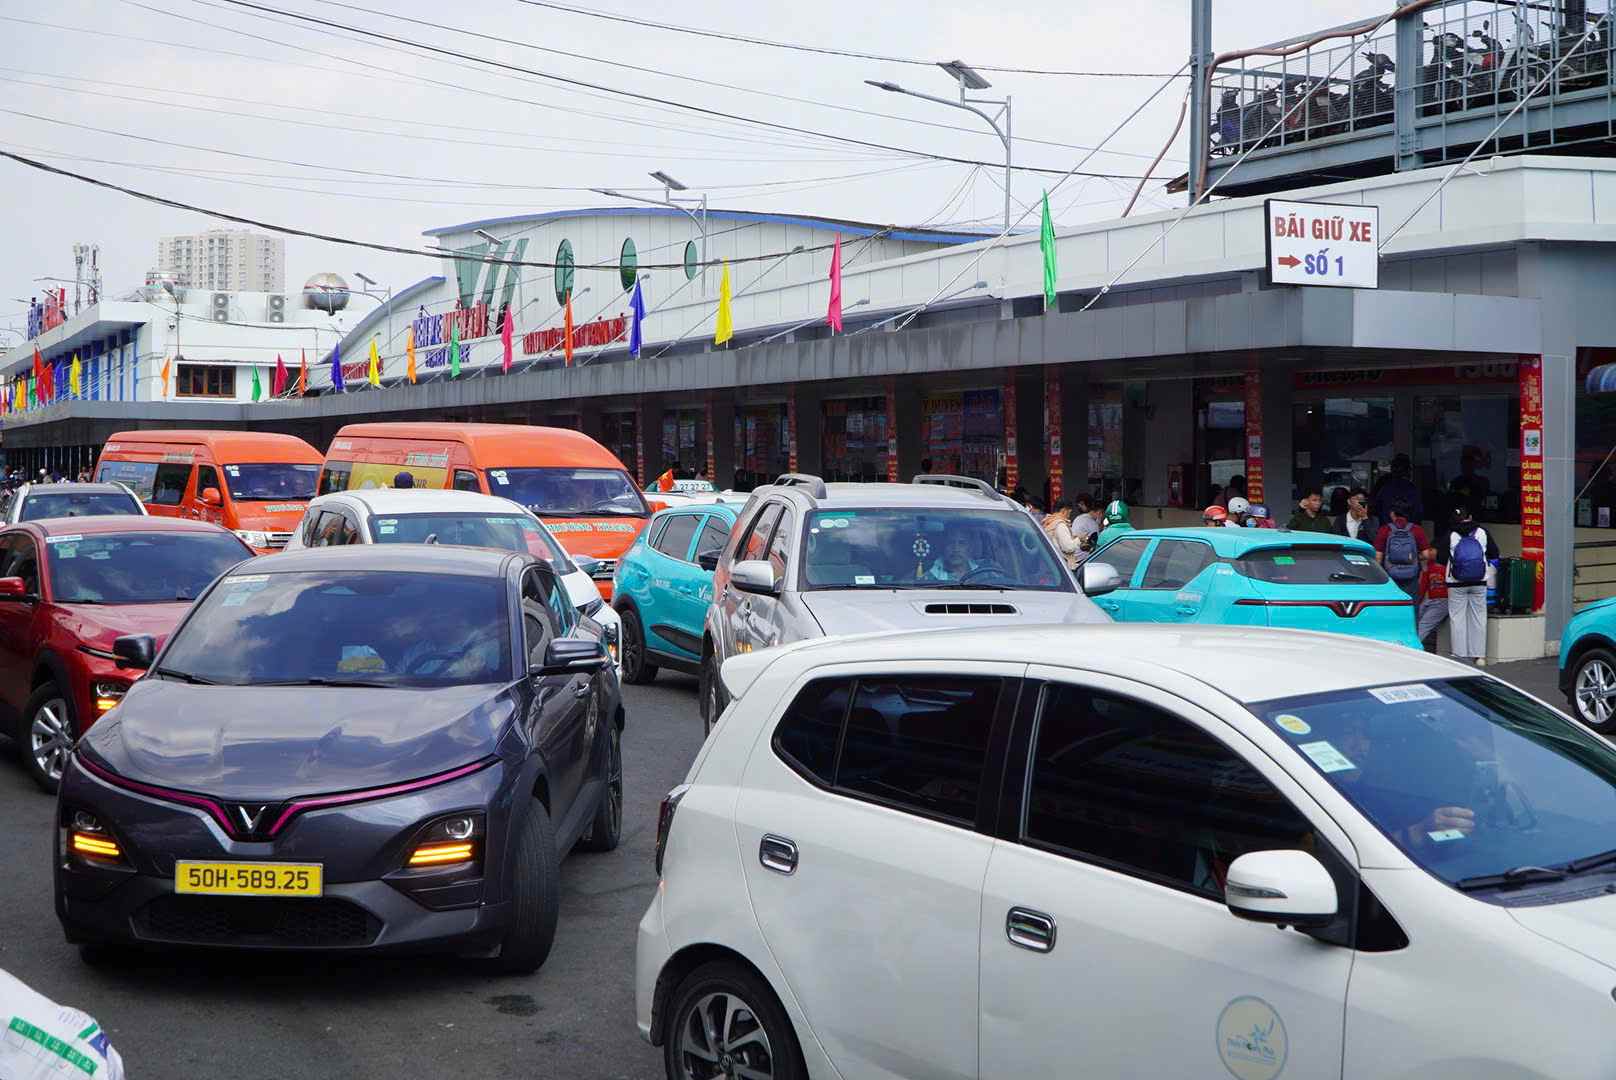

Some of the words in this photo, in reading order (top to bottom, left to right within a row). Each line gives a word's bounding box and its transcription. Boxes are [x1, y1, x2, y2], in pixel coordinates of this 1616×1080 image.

[1275, 213, 1305, 238] BÃI
[1311, 215, 1345, 241] GIỮ
[1349, 221, 1371, 242] XE
[1304, 248, 1330, 275] SỐ
[1335, 256, 1344, 277] 1
[189, 867, 310, 890] 50H-589.25
